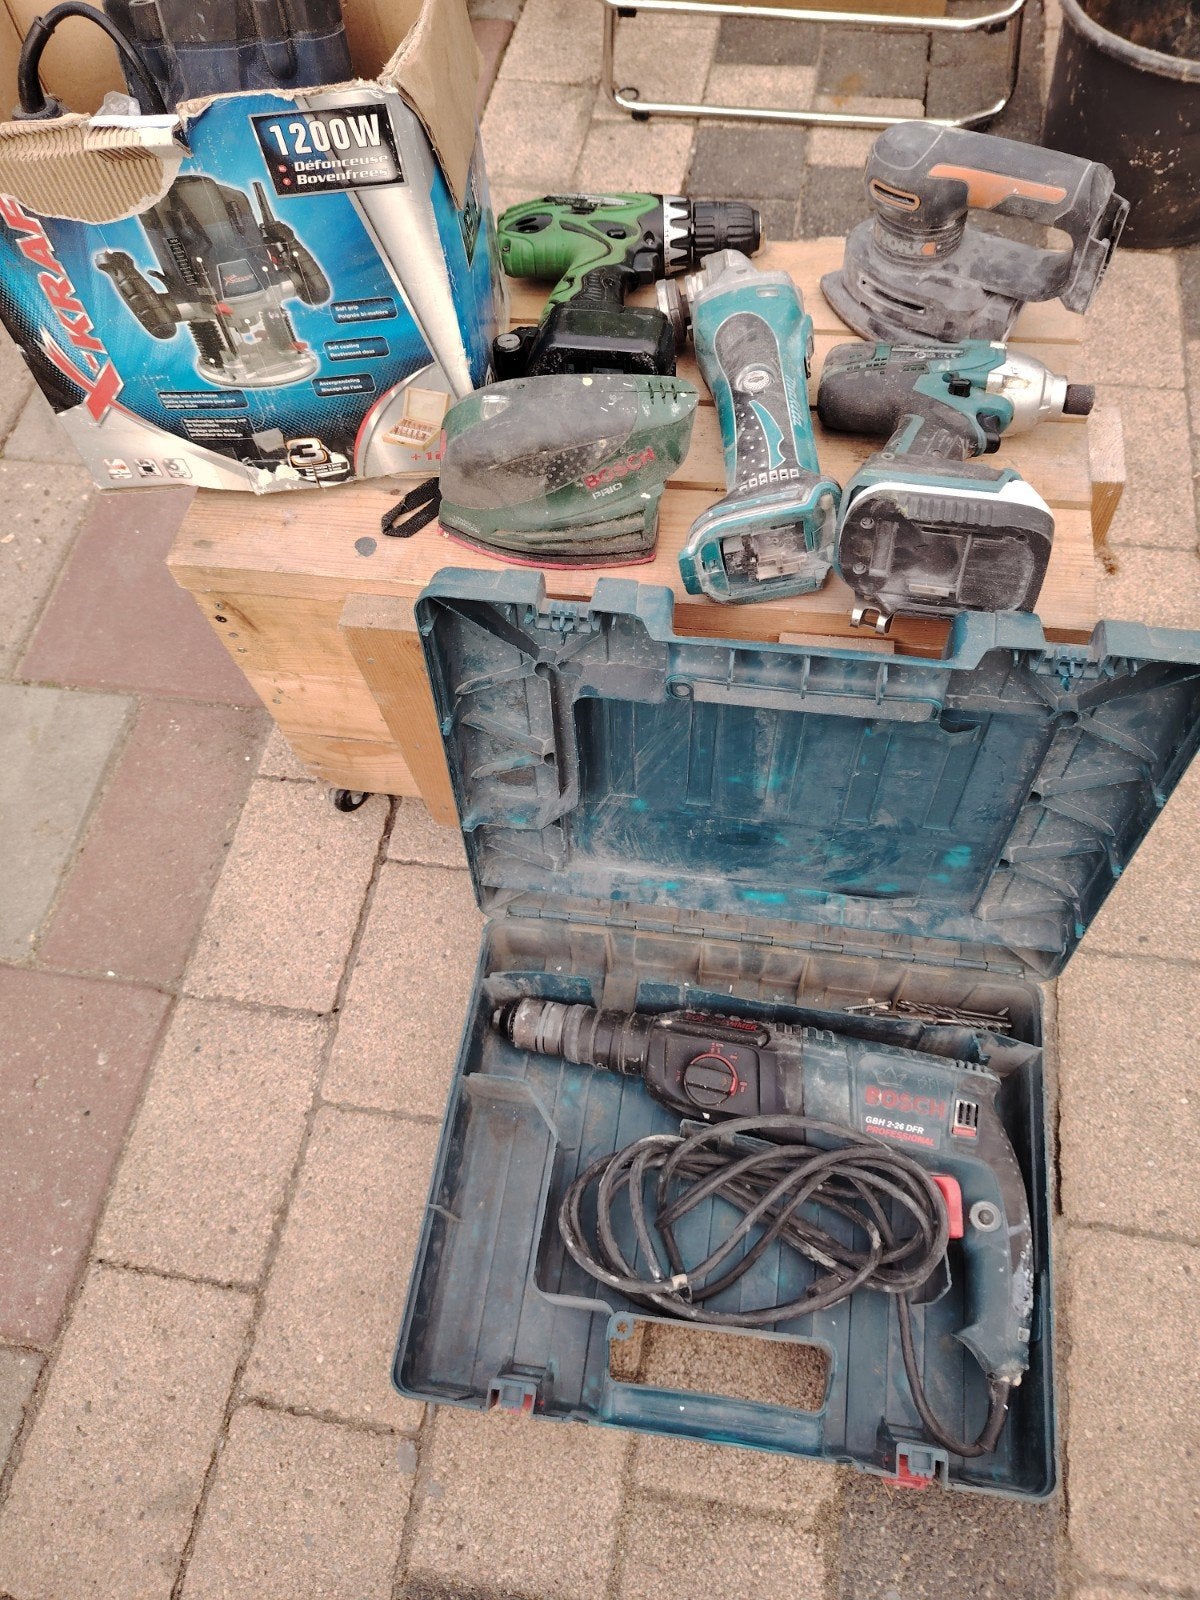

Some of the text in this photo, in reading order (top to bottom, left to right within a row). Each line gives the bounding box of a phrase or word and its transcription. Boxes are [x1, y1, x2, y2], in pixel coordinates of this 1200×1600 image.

[269, 114, 382, 156] 1200W
[294, 155, 389, 172] Défonceuse
[285, 438, 328, 466] 3
[582, 447, 656, 490] BOSCH
[592, 482, 623, 501] PRIO
[864, 1083, 946, 1120] BOSCH
[865, 1115, 886, 1127] GBH
[906, 1123, 925, 1135] DFR
[865, 1125, 935, 1147] PROFESSIONAL
